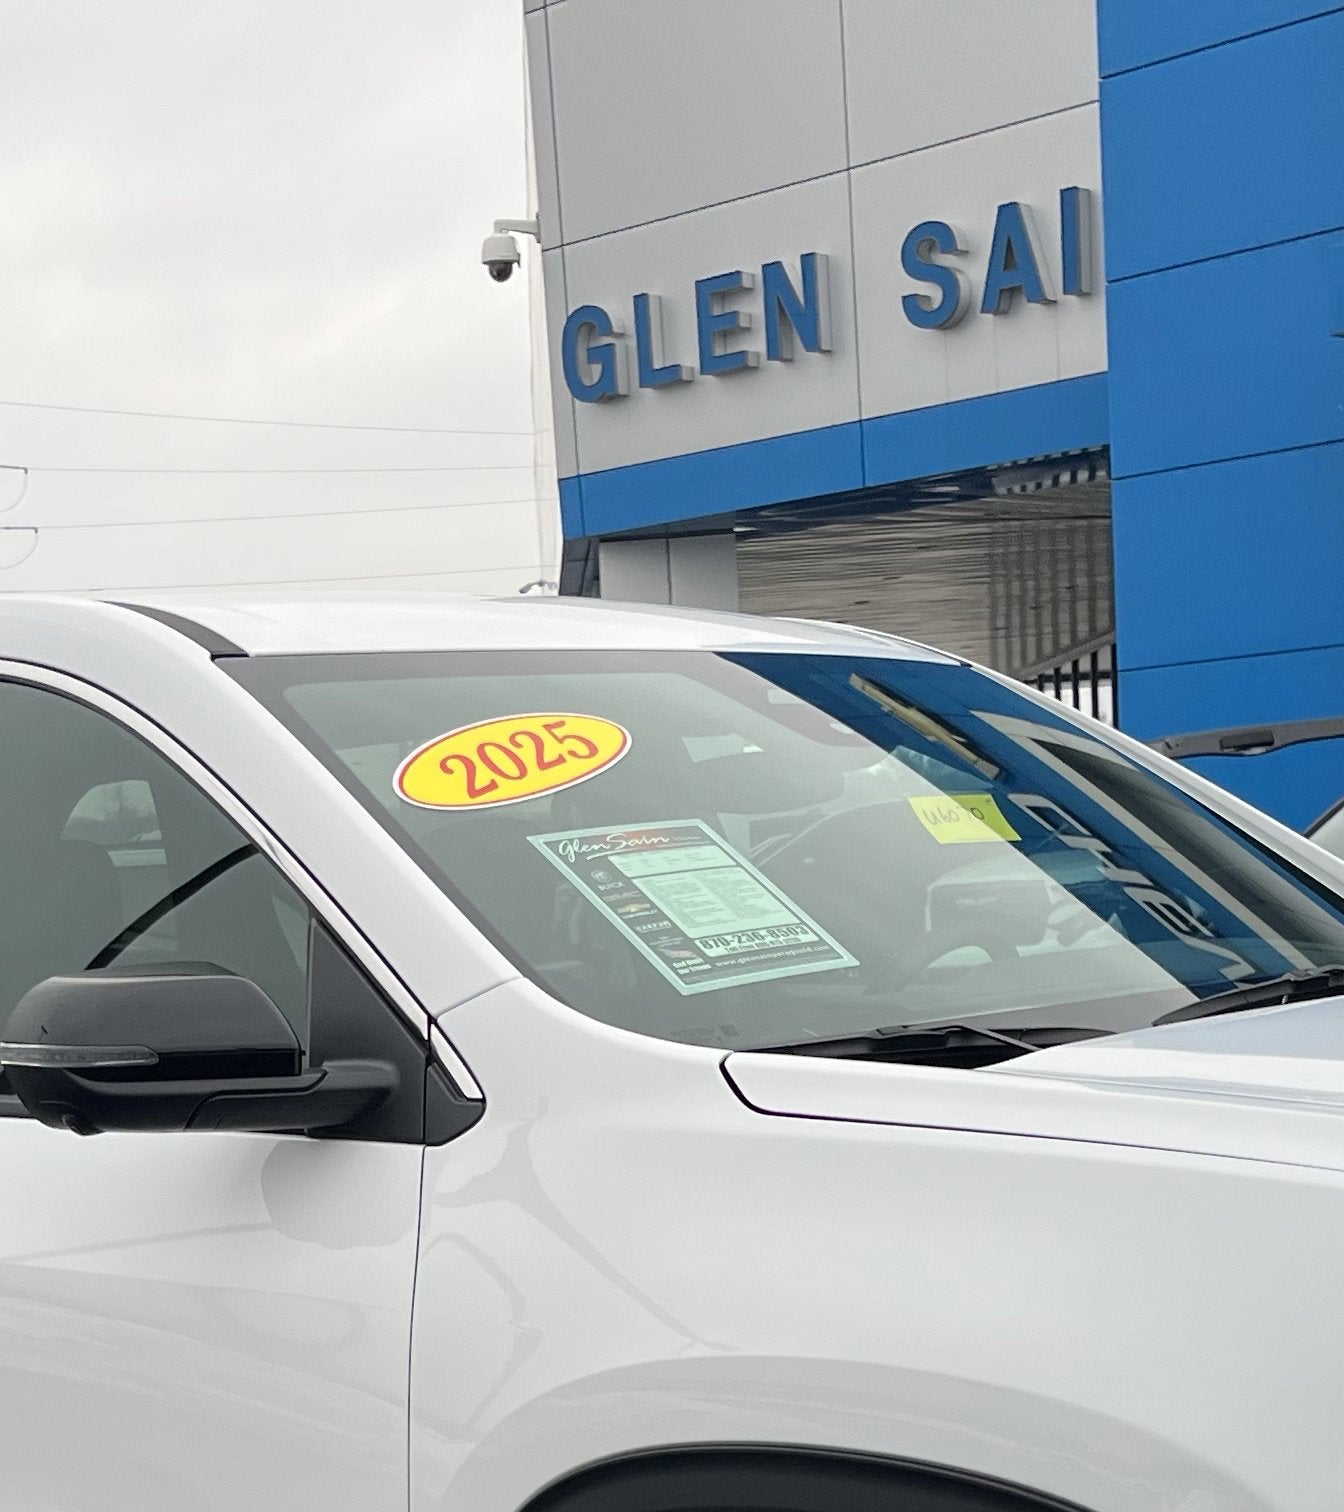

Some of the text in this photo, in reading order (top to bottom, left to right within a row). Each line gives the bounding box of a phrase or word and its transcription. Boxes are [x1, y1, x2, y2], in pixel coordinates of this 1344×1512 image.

[562, 185, 1093, 403] GLEN SAI
[439, 720, 599, 800] 2025
[606, 833, 670, 850] Sain
